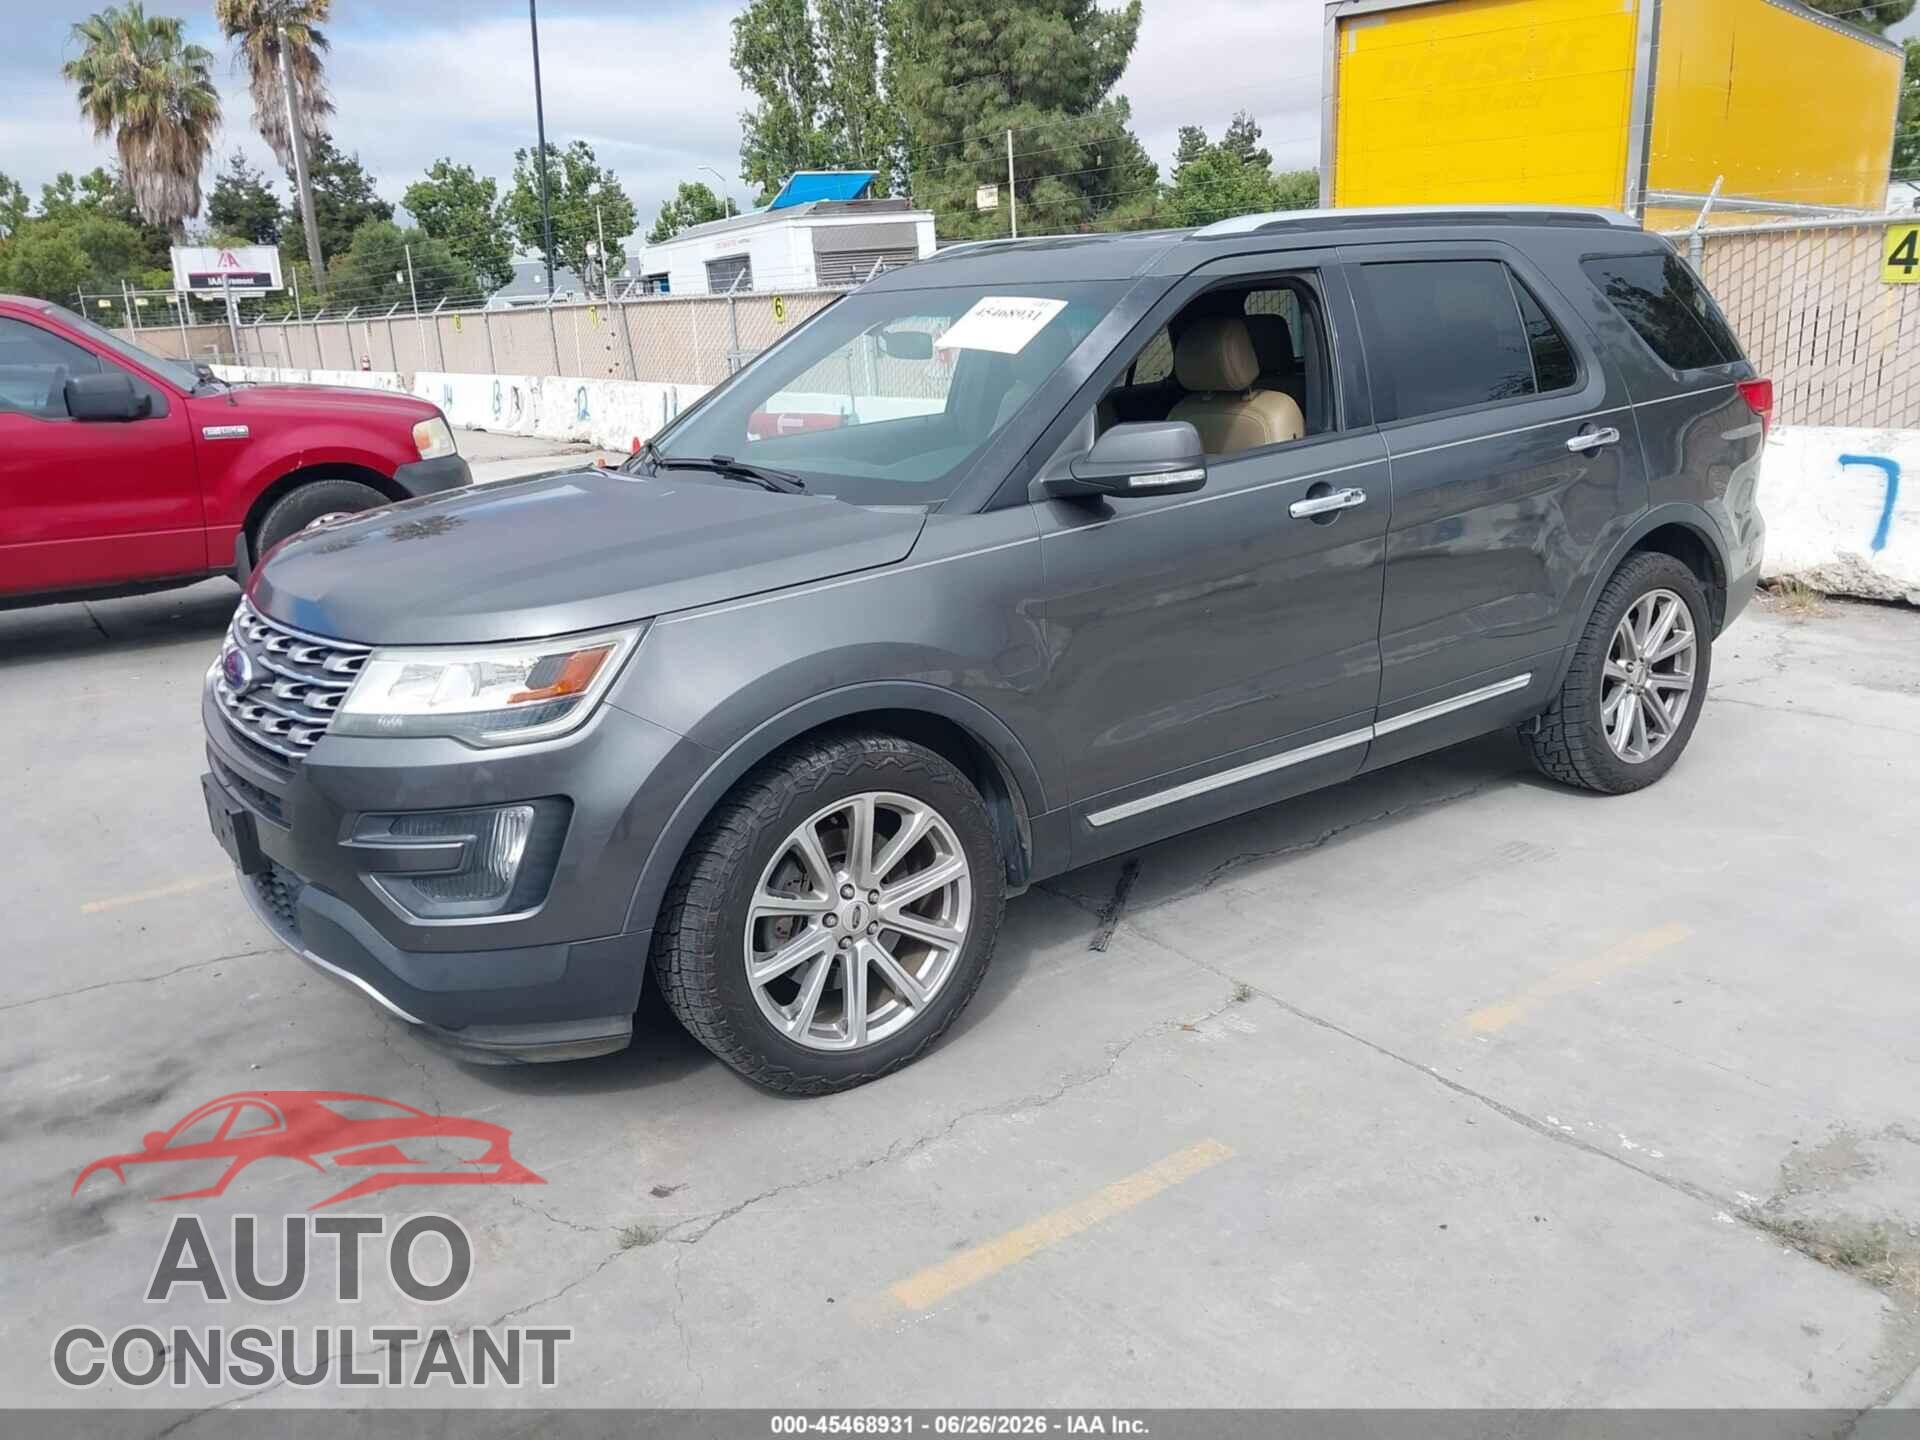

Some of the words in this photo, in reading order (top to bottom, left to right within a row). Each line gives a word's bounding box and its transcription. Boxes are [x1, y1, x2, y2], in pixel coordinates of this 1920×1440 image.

[1887, 229, 1919, 275] 4
[775, 296, 783, 318] 6
[1837, 453, 1901, 554] 7
